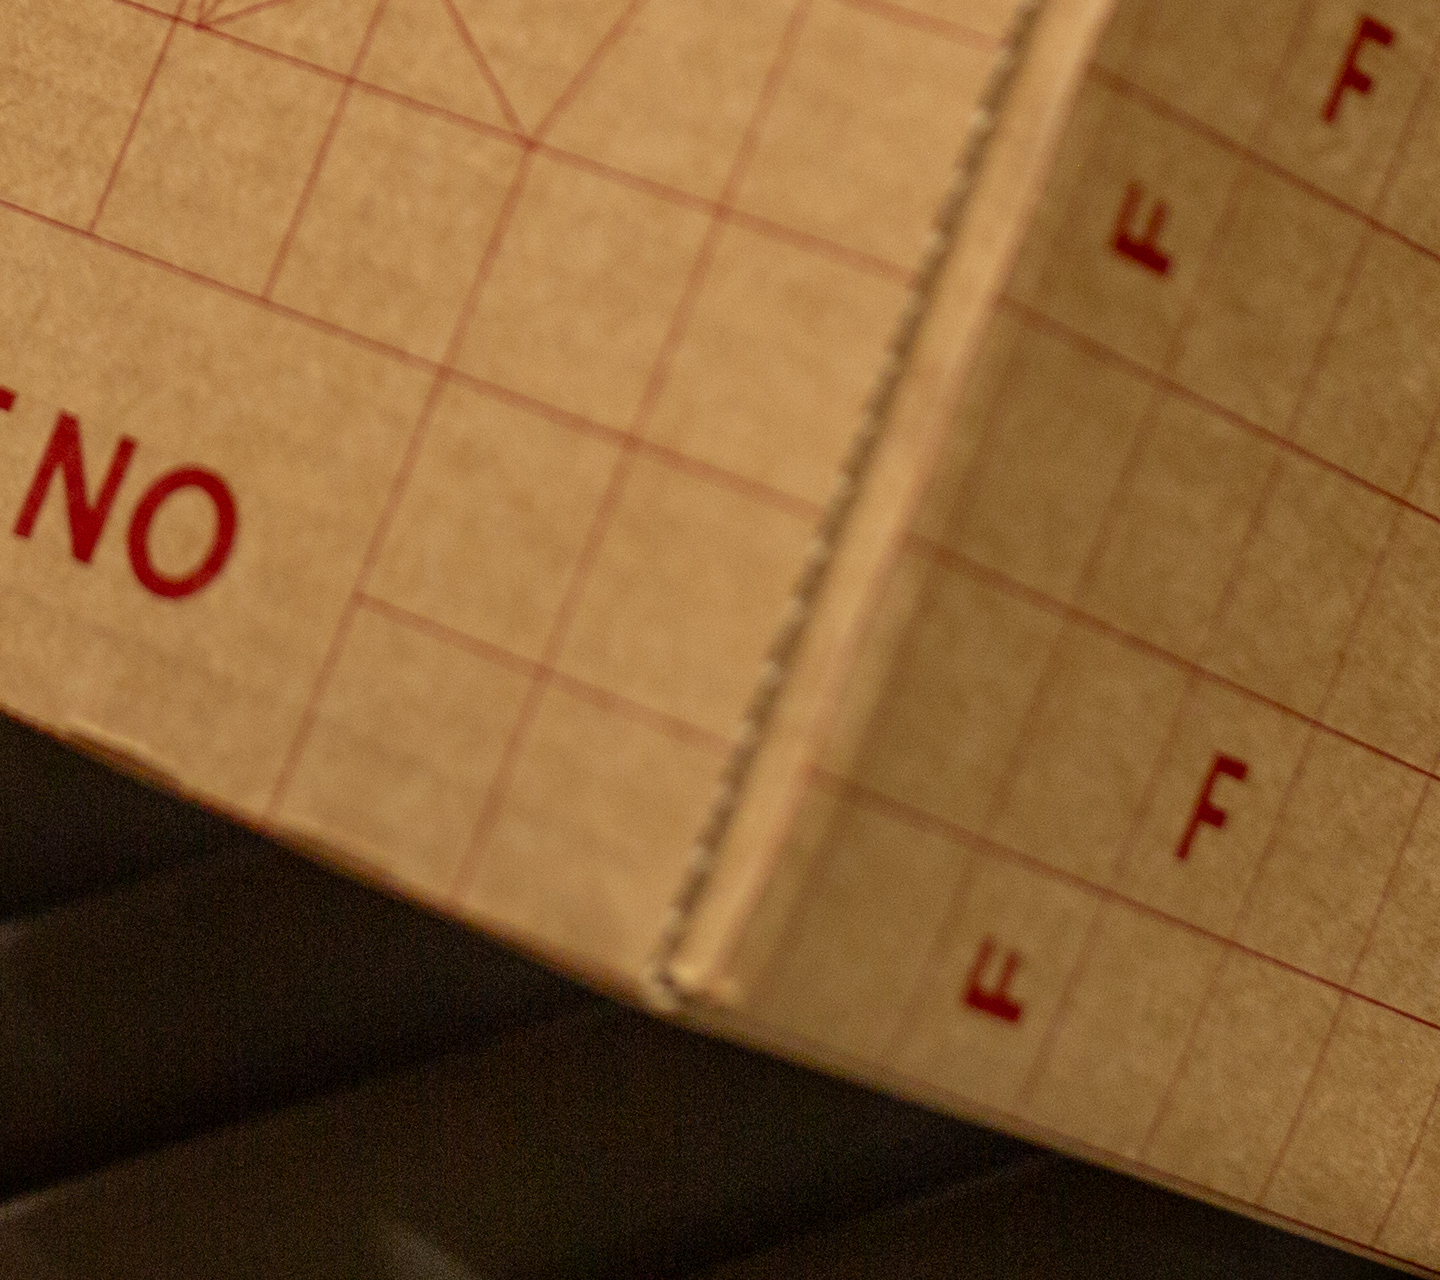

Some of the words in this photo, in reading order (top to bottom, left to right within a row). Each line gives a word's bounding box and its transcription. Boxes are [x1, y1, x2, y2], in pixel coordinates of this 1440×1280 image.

[1324, 16, 1395, 123] F
[1112, 183, 1173, 277] F
[1177, 755, 1247, 860] F
[964, 941, 1024, 1024] F
